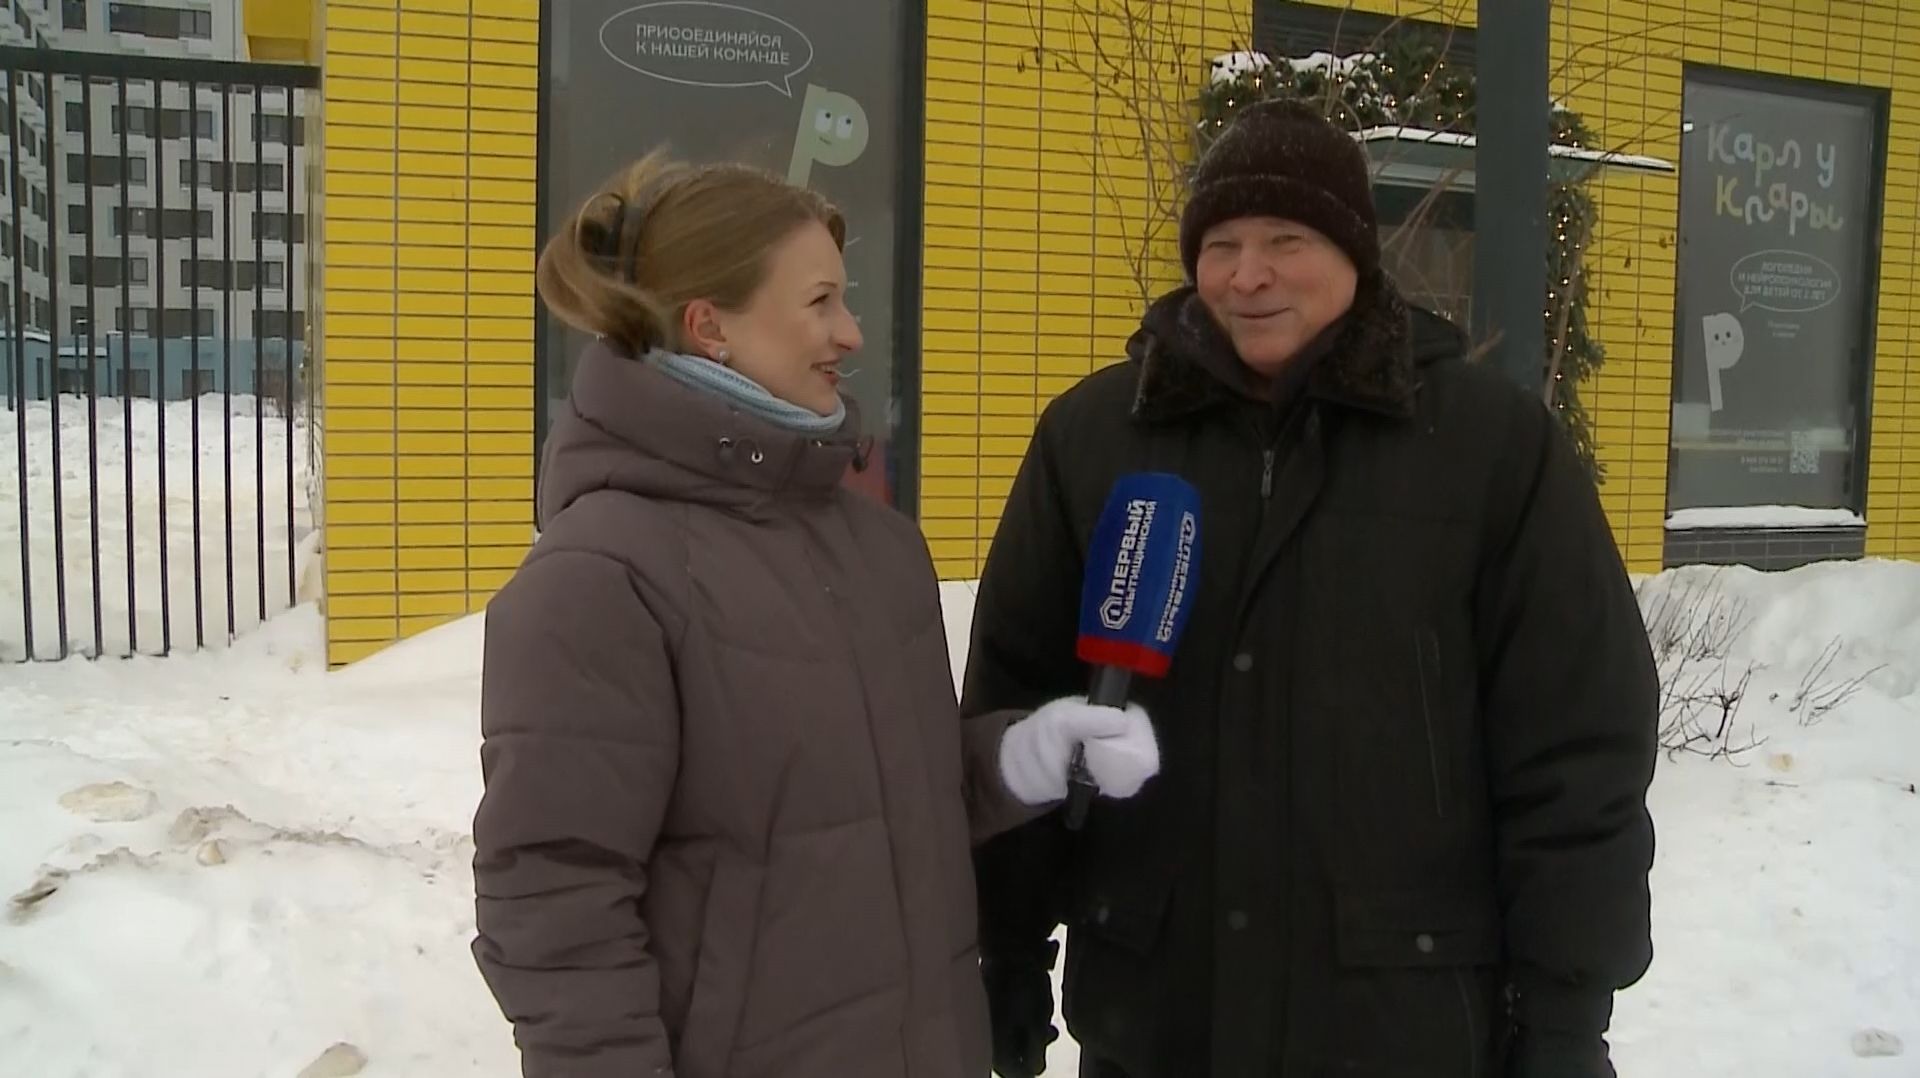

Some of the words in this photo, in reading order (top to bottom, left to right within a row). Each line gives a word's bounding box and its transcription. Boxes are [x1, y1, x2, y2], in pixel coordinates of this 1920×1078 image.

[636, 41, 647, 55] К
[651, 41, 709, 60] НАШЕЙ
[713, 47, 790, 66] КОМАНДЕ
[1707, 122, 1801, 188] Карл
[1716, 175, 1844, 236] Клары
[1110, 498, 1147, 595] ПЕРВЫЙ
[1124, 500, 1157, 615] МЫТИЩИНСКИЙ
